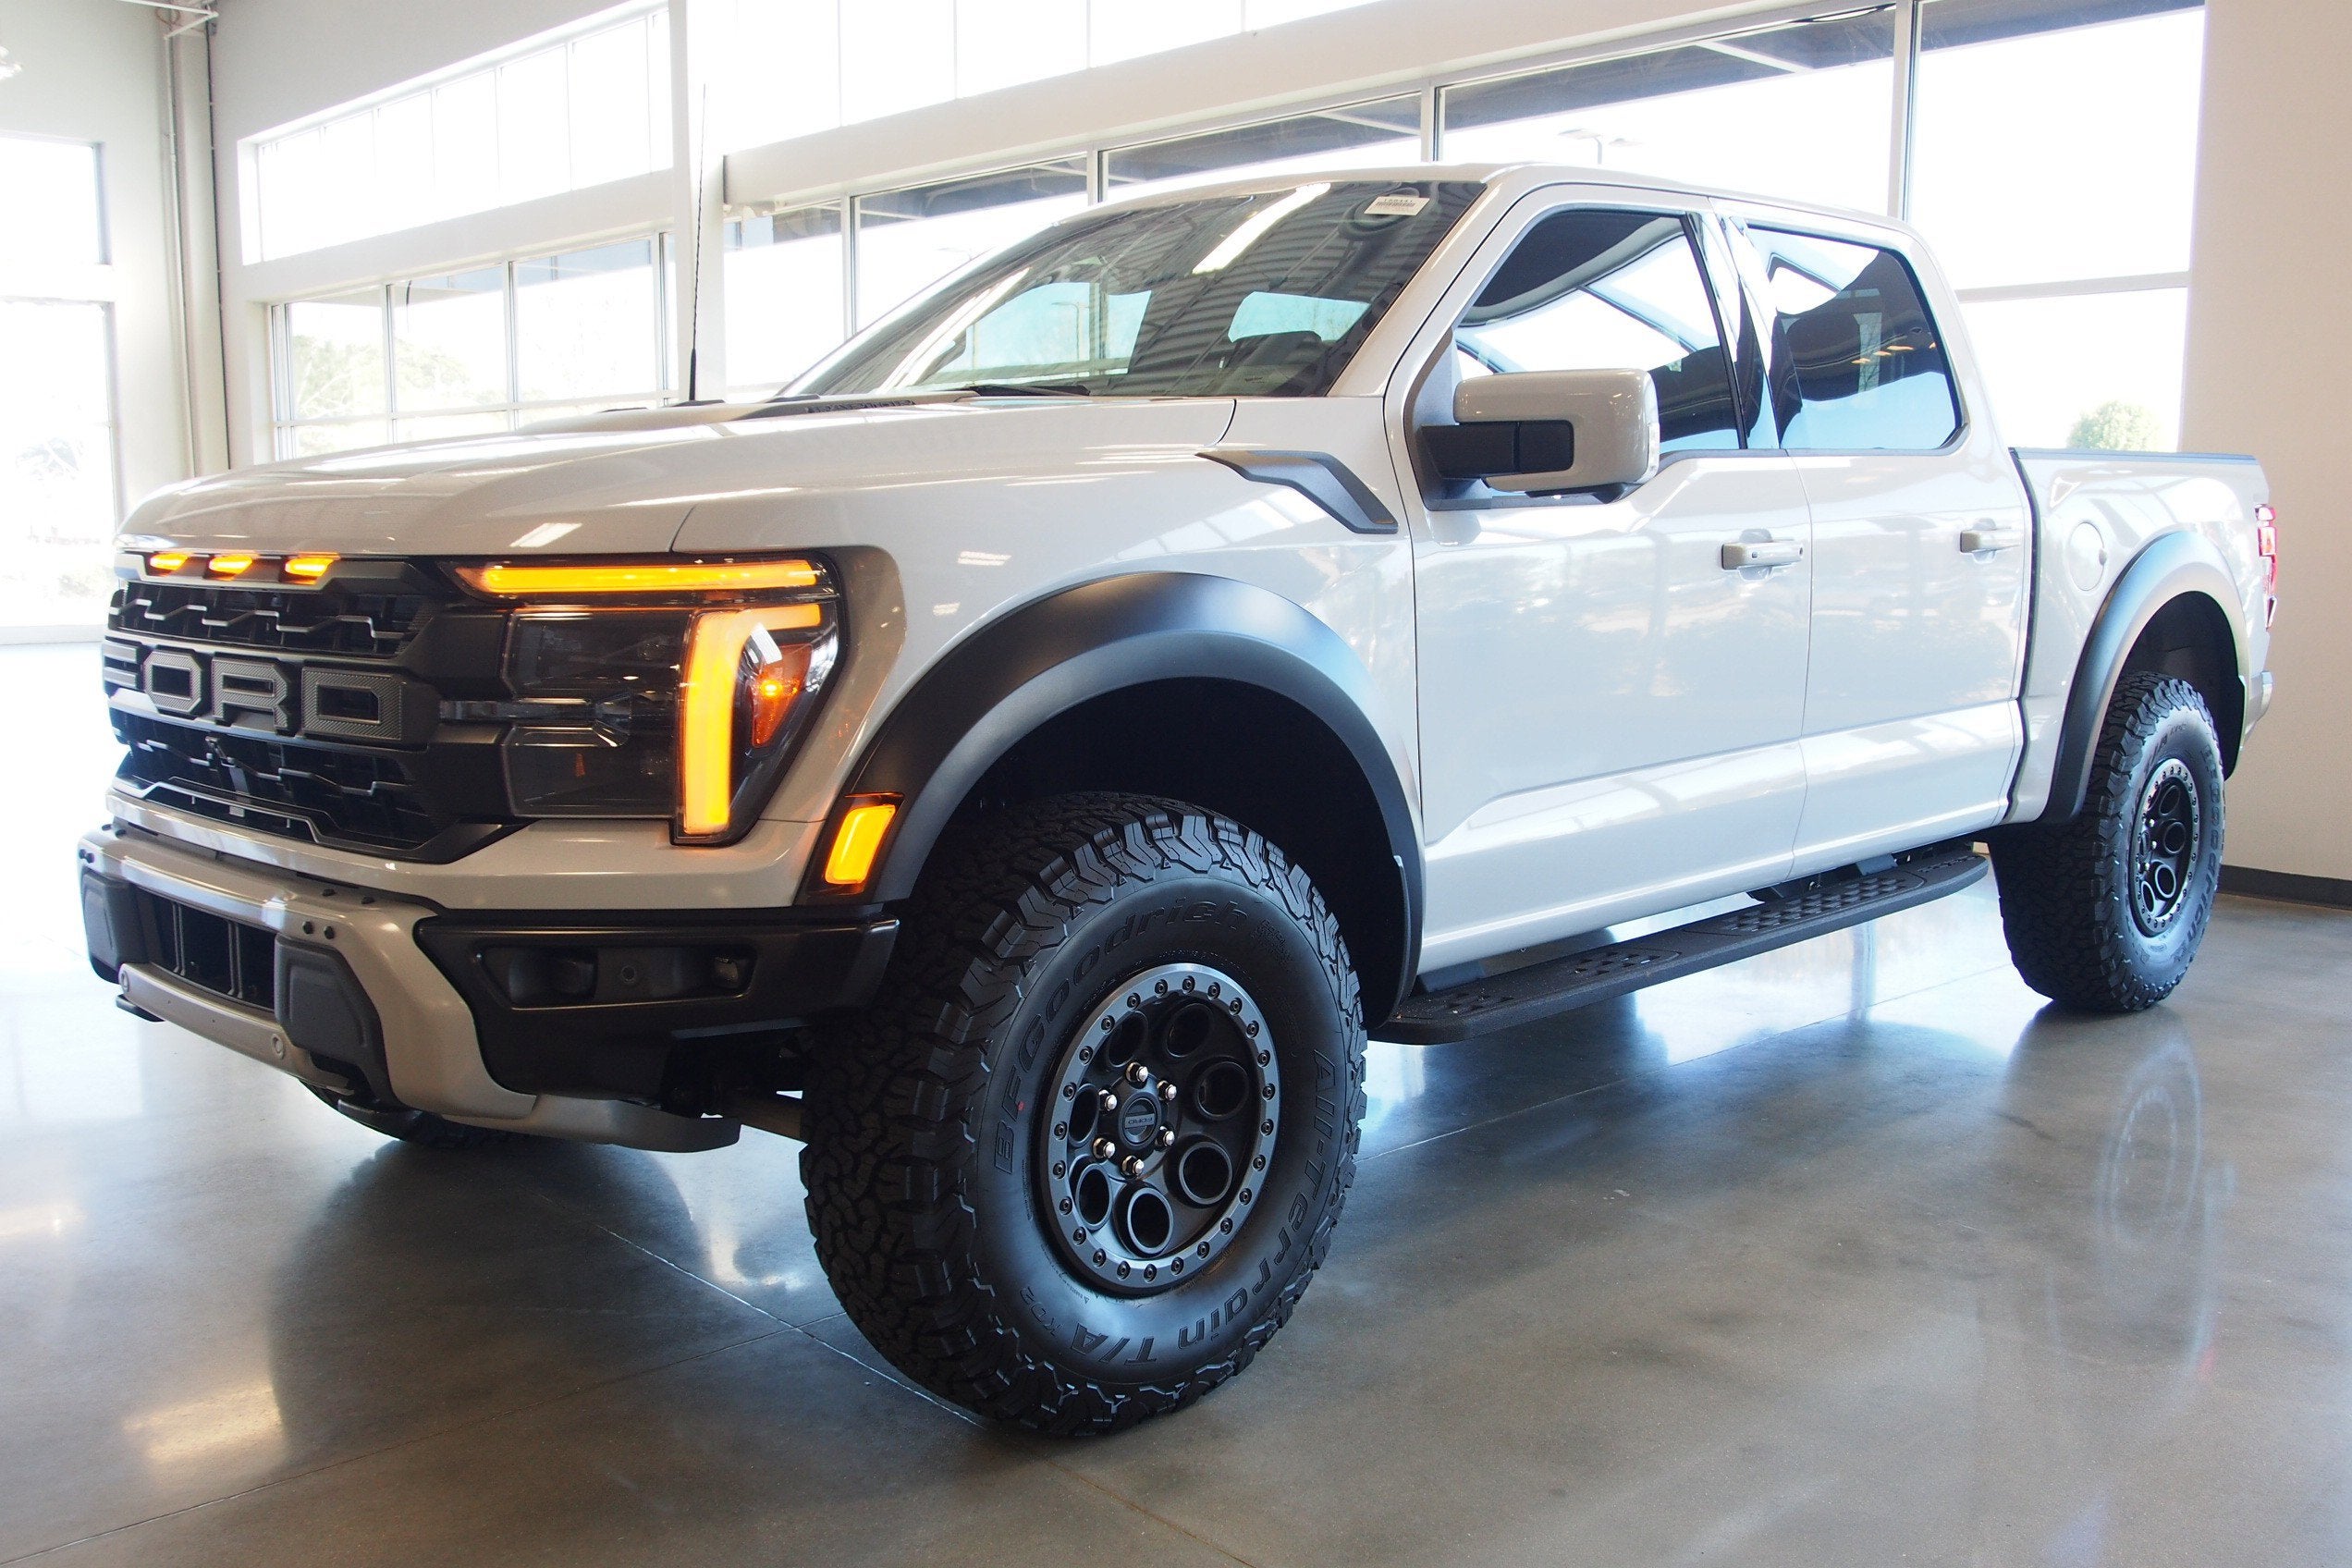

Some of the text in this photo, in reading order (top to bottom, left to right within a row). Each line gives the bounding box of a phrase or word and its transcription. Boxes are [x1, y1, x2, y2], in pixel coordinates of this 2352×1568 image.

[994, 895, 1249, 1175] BFGoodrich
[1128, 1117, 1154, 1125] FORD
[1177, 1048, 1337, 1350] All-Terrain
[1070, 1321, 1158, 1366] T/A
